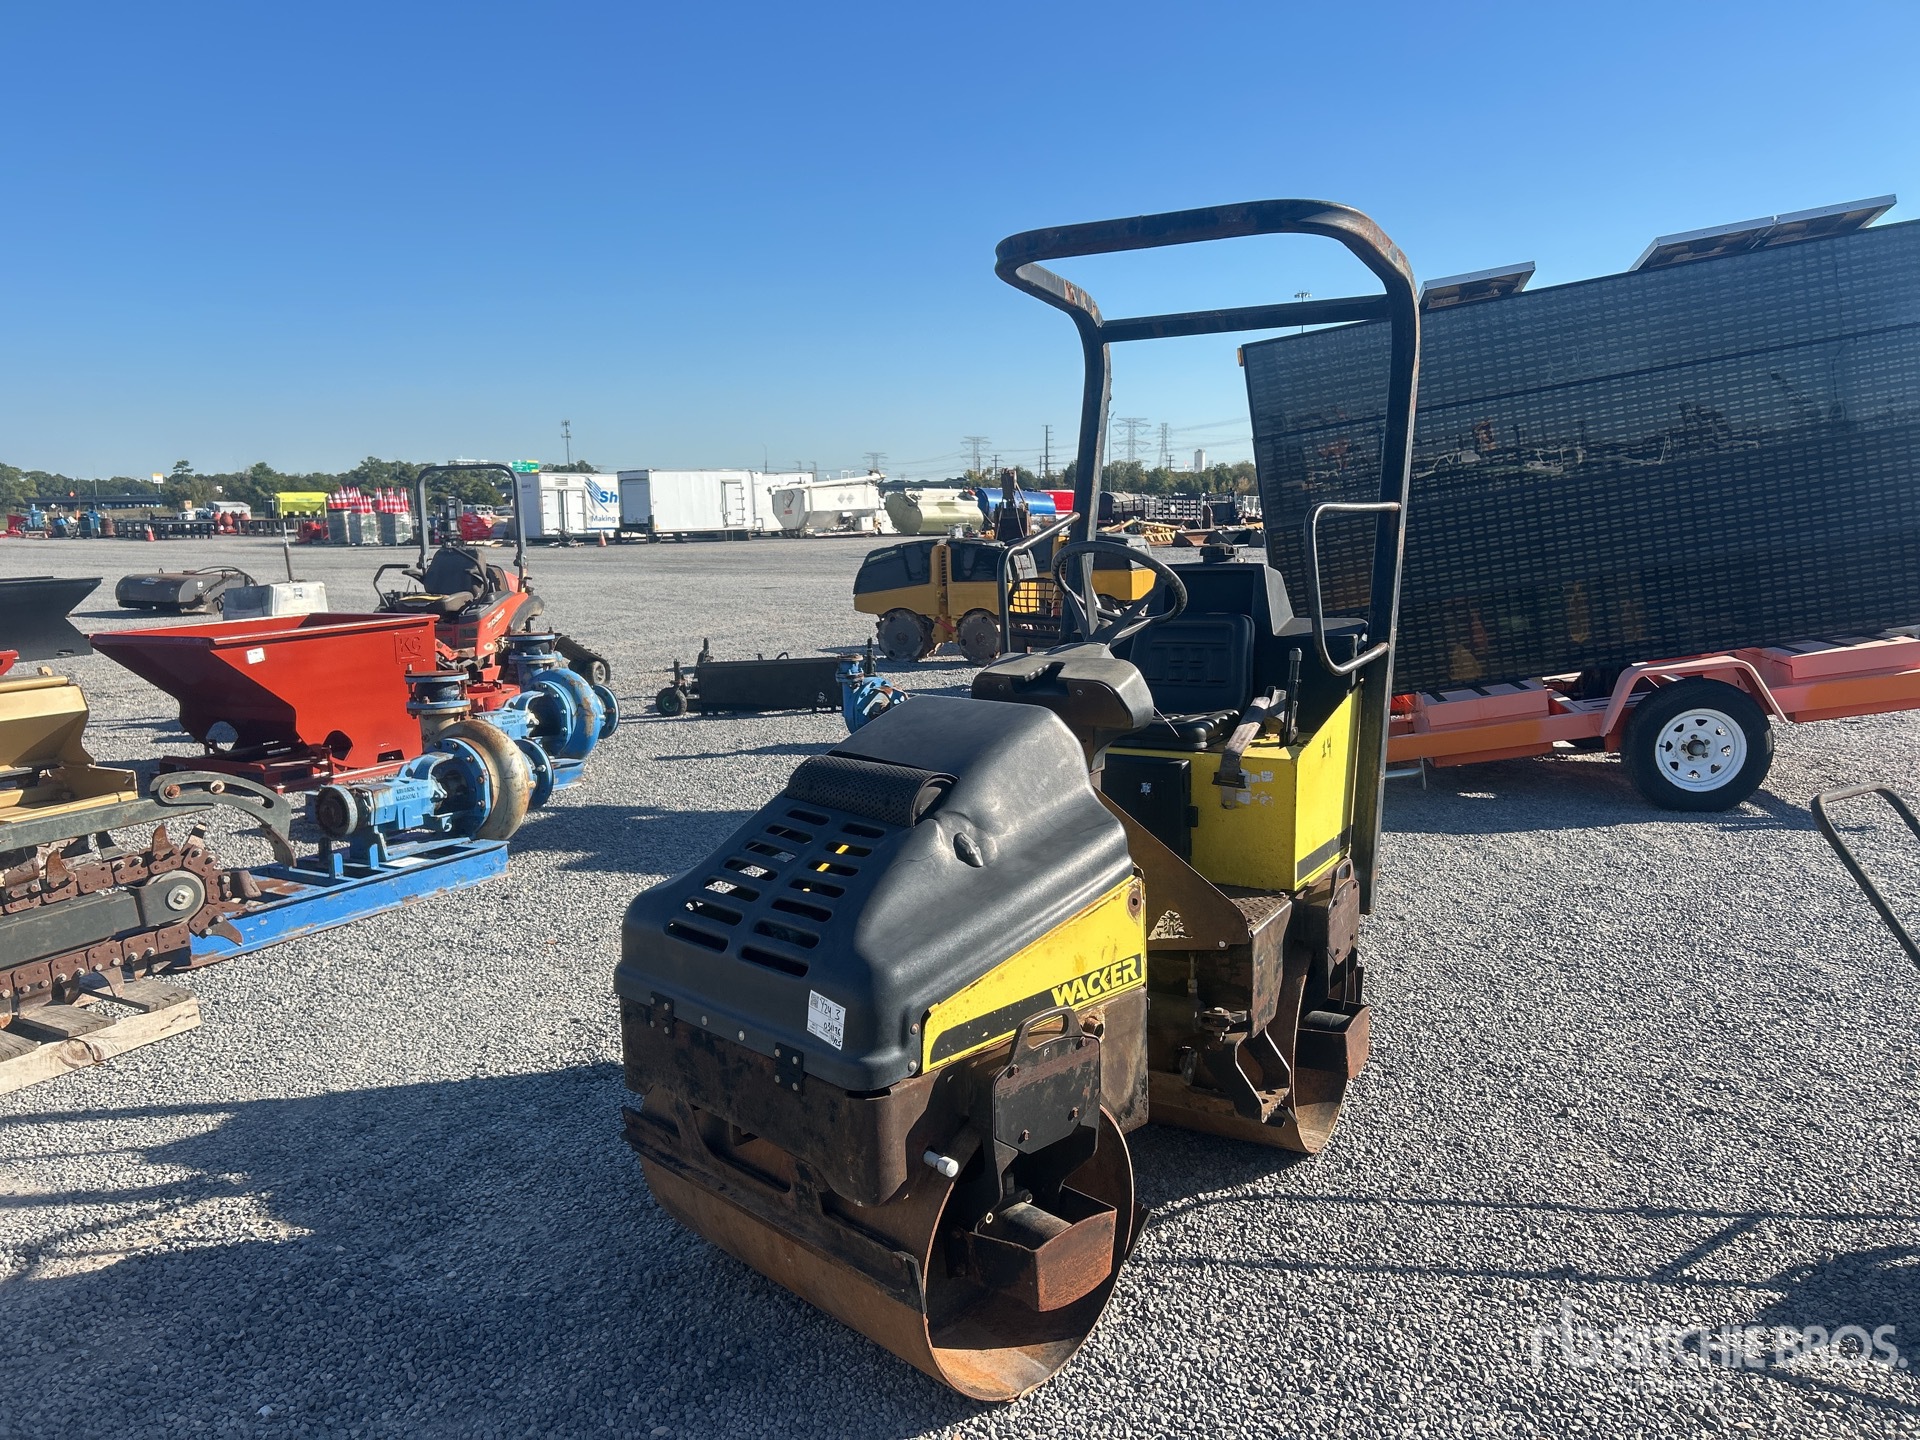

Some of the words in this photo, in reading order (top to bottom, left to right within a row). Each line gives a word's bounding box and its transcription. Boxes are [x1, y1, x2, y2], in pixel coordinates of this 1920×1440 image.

[592, 515, 616, 523] Making
[1051, 957, 1138, 1006] WACKER
[835, 1009, 841, 1020] 3
